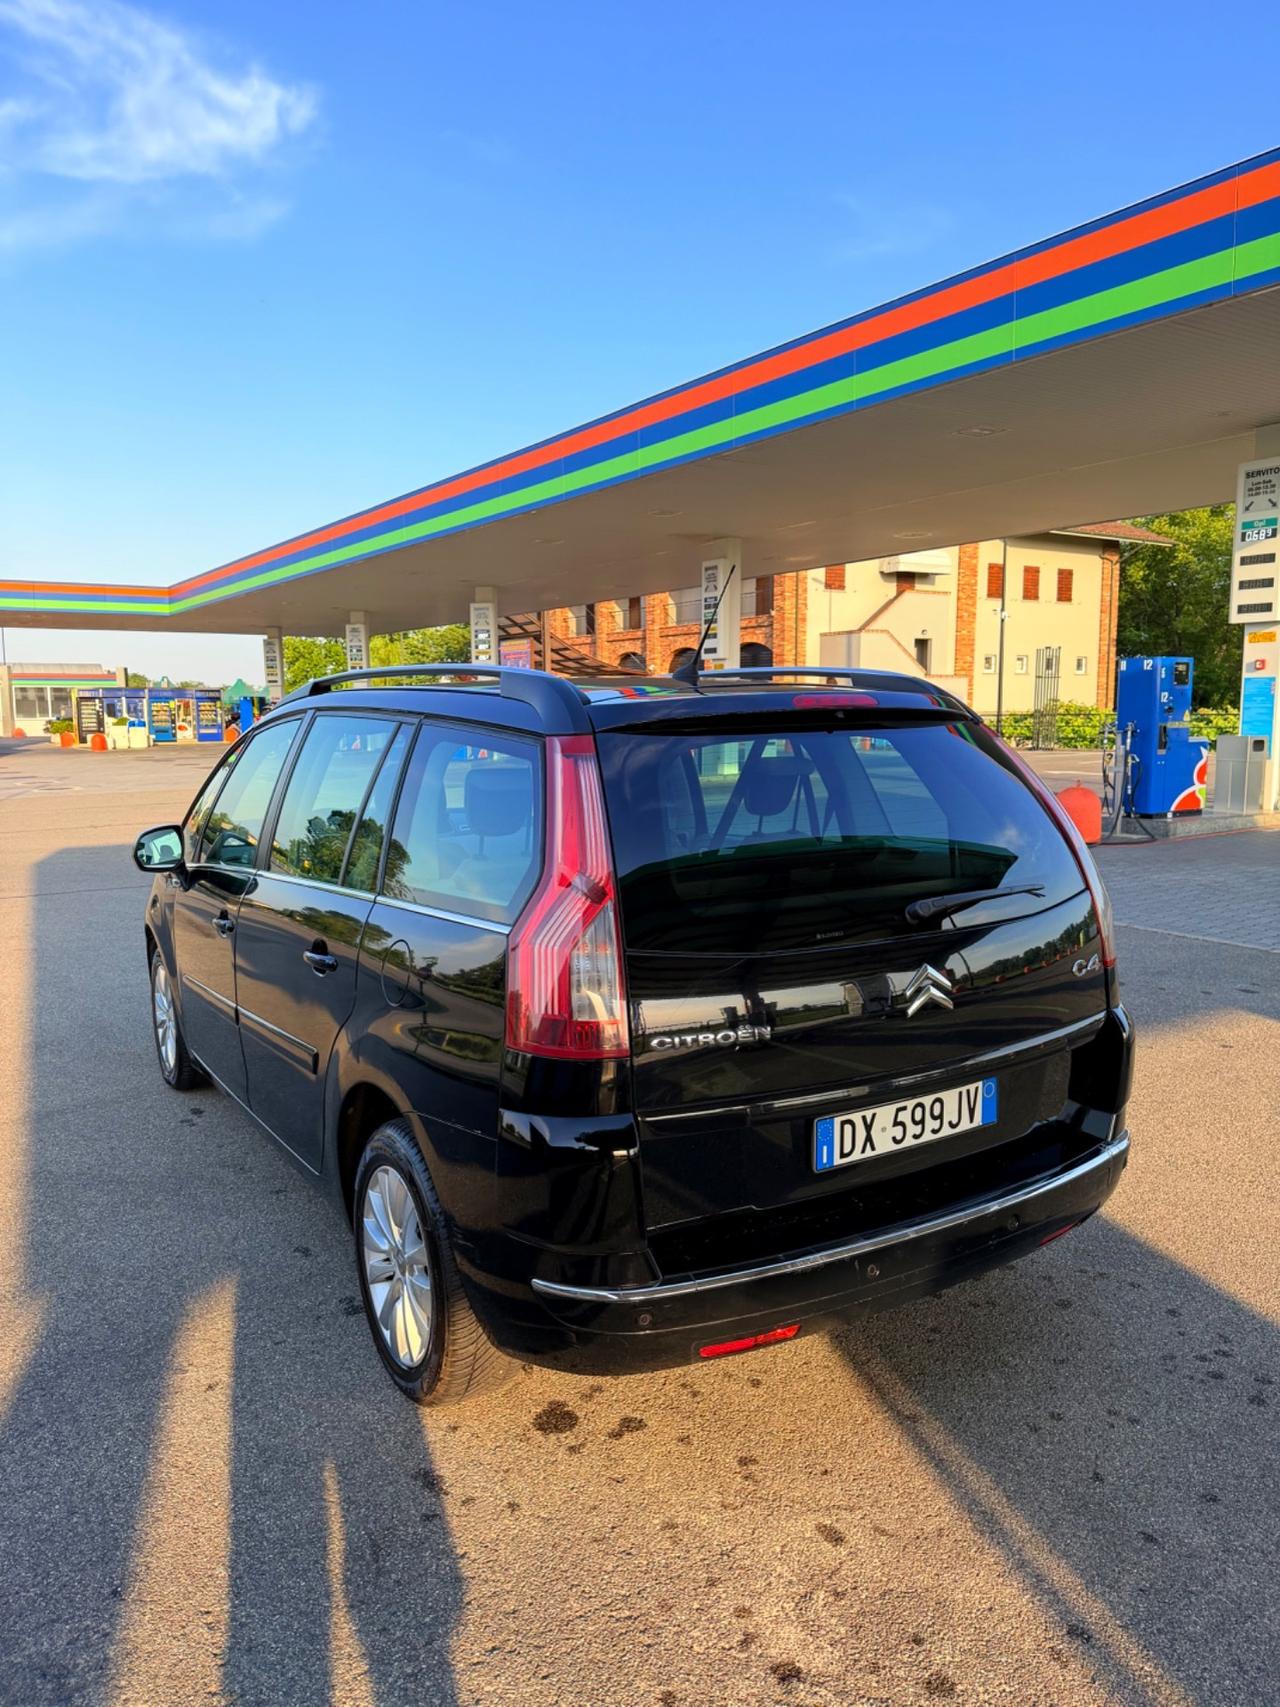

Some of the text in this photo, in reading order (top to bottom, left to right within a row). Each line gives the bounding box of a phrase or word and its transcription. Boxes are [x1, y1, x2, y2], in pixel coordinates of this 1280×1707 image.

[1245, 467, 1280, 479] SERVITO
[1143, 659, 1153, 670] 12
[1161, 692, 1169, 703] 12
[1072, 953, 1099, 977] C4
[650, 1024, 772, 1050] CITROËN
[839, 1112, 877, 1160] DX
[891, 1086, 980, 1146] 599JV
